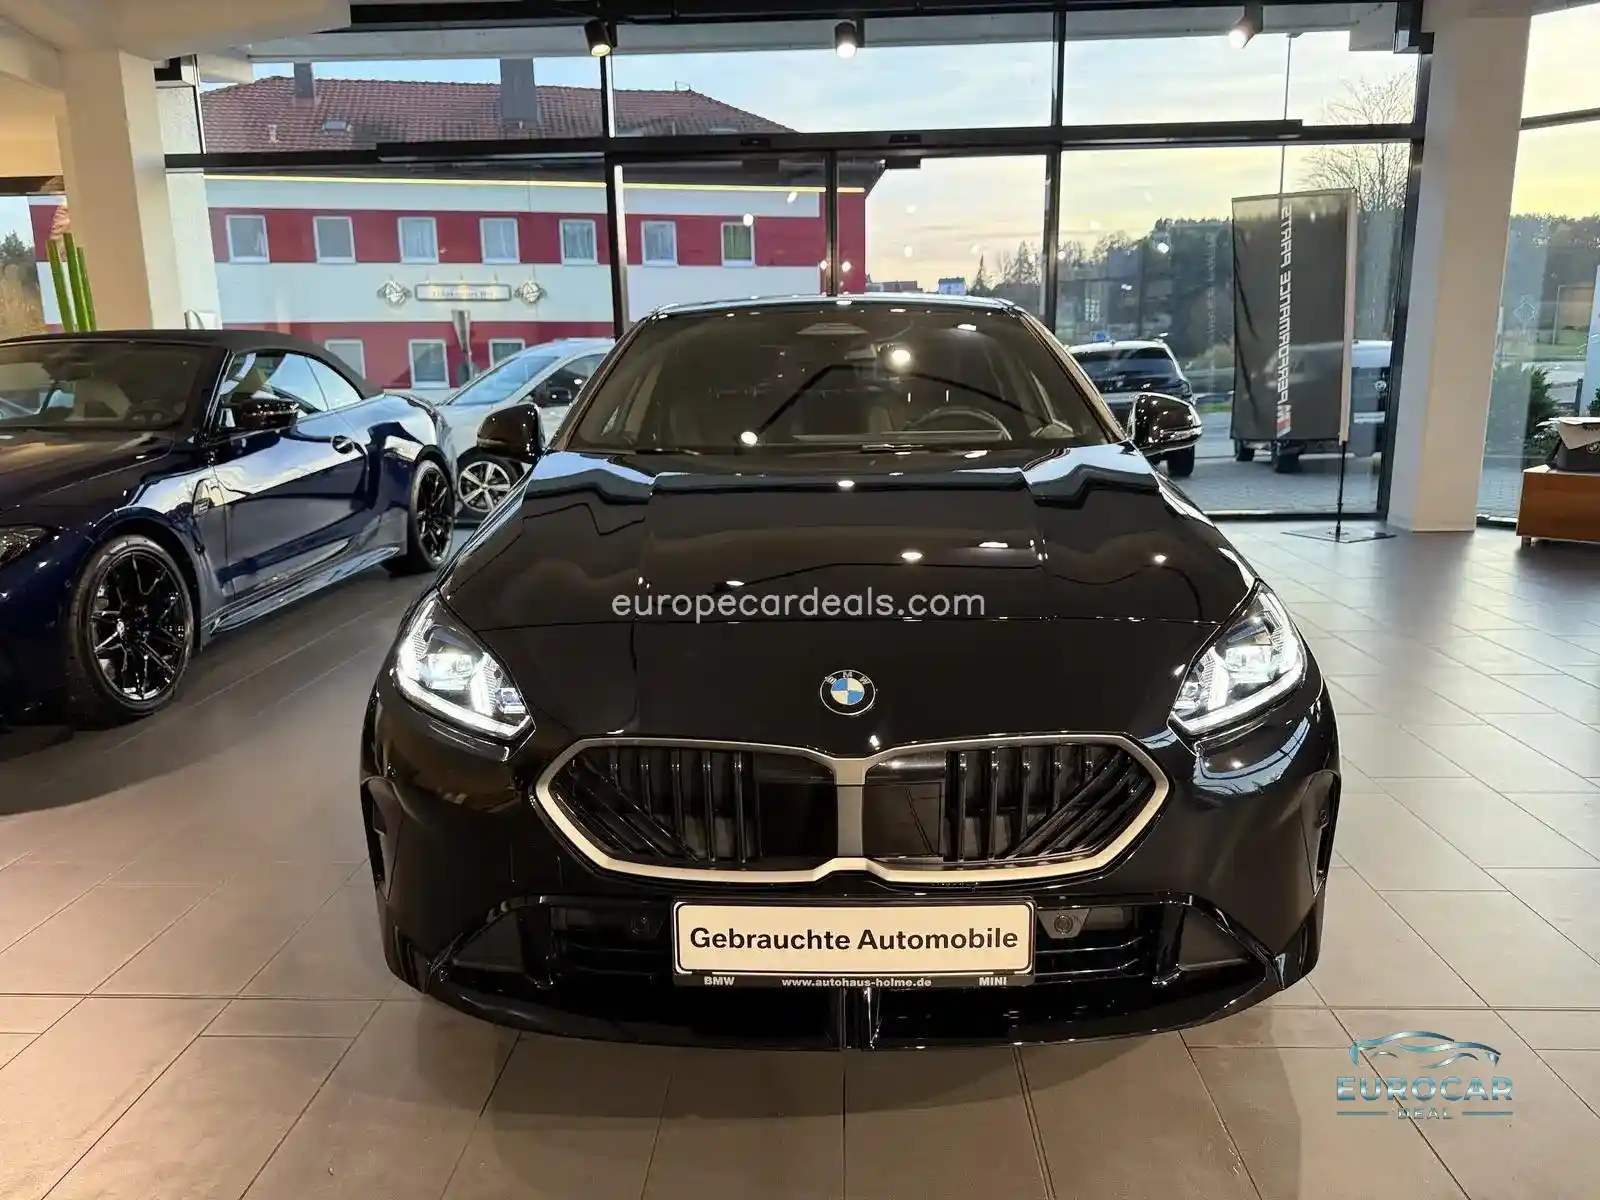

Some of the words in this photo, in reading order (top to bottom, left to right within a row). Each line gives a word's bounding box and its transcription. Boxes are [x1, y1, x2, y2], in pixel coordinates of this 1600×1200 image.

[825, 671, 871, 685] BMW
[690, 926, 851, 950] Gebrauchte
[857, 928, 1018, 950] Automobile
[704, 976, 735, 986] BMW
[979, 976, 1007, 986] MINI
